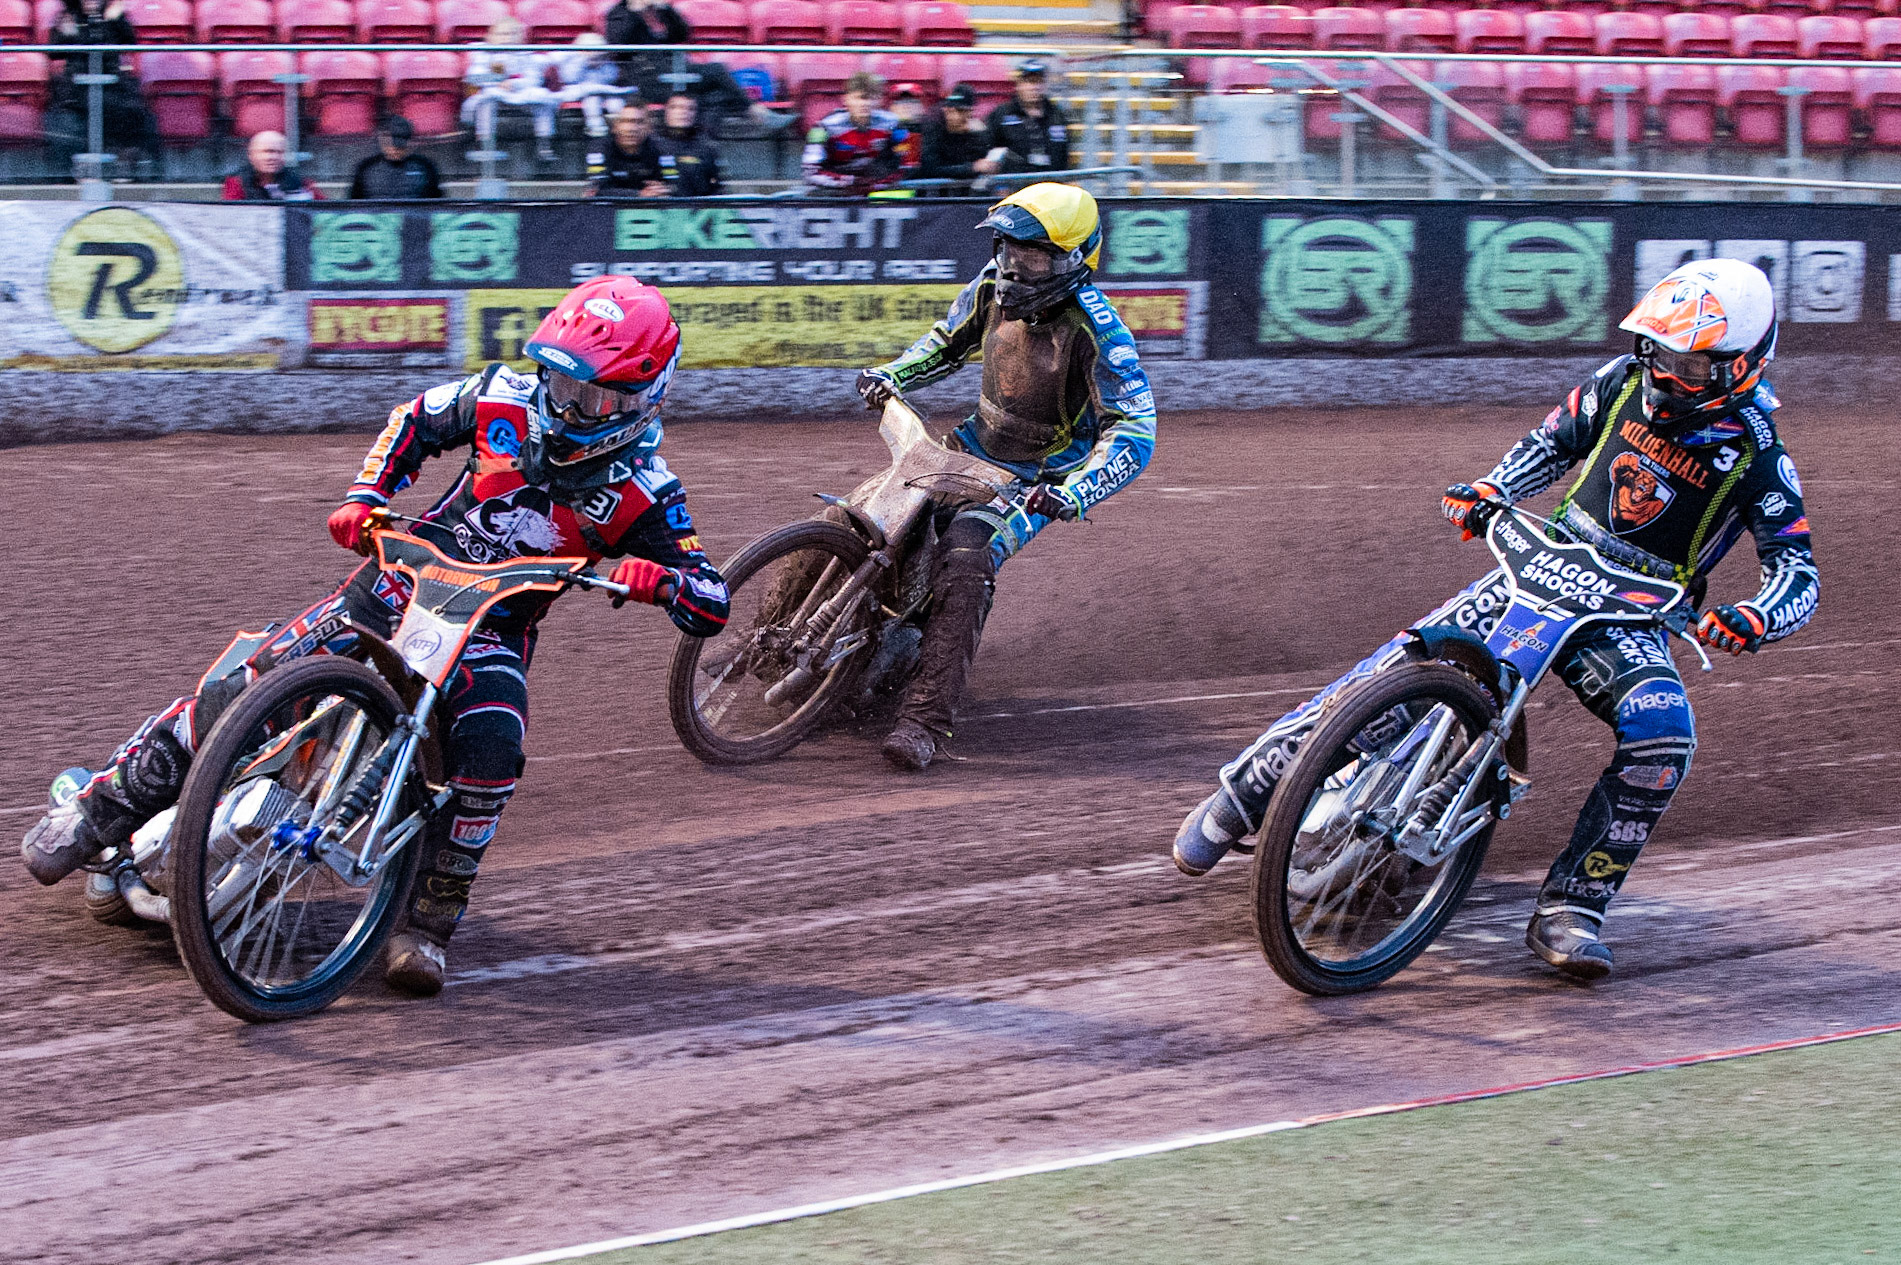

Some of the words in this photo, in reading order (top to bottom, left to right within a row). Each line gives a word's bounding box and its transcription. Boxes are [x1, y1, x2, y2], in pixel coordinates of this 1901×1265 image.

[592, 303, 617, 318] BELL
[1078, 290, 1112, 325] DAD
[527, 403, 541, 444] LEATT
[1747, 406, 1774, 449] HAGON
[1076, 447, 1134, 498] PLANET
[1619, 419, 1709, 489] MILDENHALL
[1651, 461, 1671, 479] TIGERS
[1713, 445, 1740, 472] 3
[1082, 463, 1142, 508] HONDA
[1519, 563, 1605, 611] SHOCKS
[1530, 550, 1618, 596] HAGON
[1772, 580, 1819, 630] HAGON
[1500, 624, 1550, 653] HAGON
[1608, 820, 1650, 841] SBS
